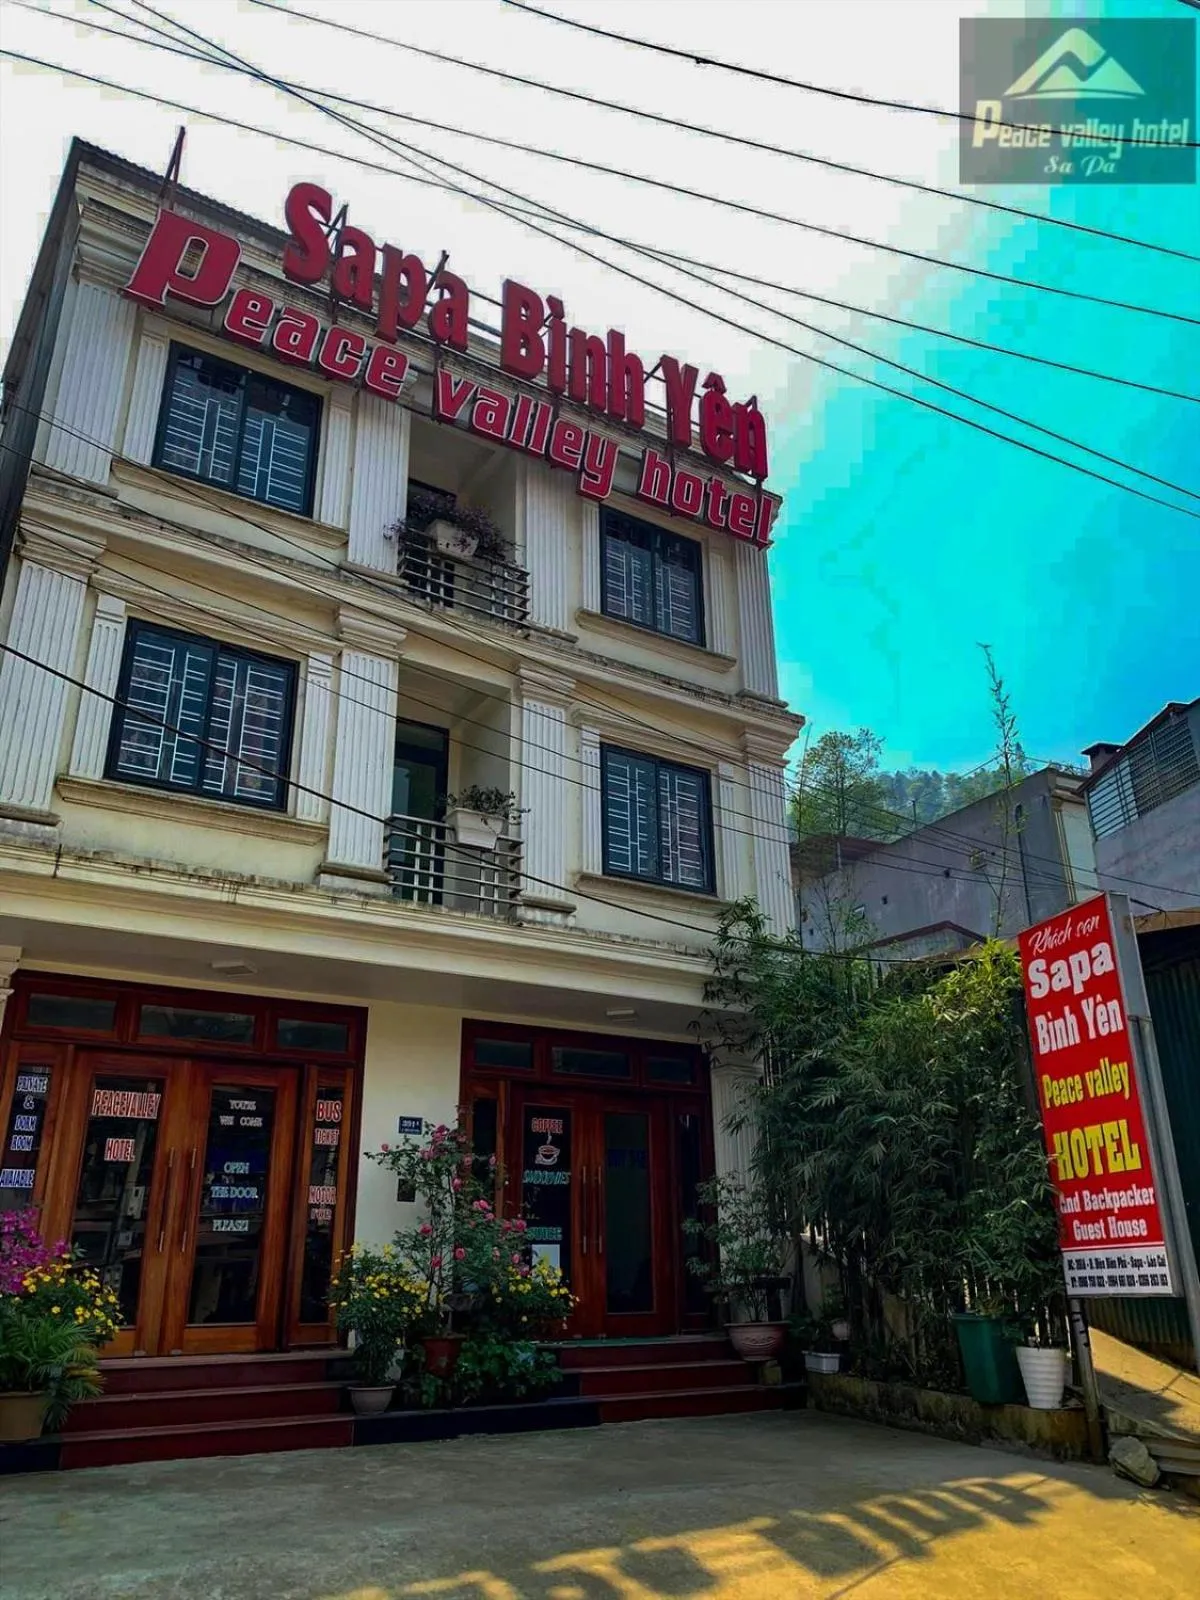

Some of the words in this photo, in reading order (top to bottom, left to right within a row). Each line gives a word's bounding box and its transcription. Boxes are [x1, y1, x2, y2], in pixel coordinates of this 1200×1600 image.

[282, 182, 469, 353] Sapa
[501, 279, 645, 431] Bình
[661, 355, 768, 480] Yên
[122, 206, 410, 401] Peace
[432, 368, 620, 499] valley
[637, 447, 777, 551] hotel
[1028, 917, 1073, 957] Khách
[1074, 915, 1100, 938] sạn
[1028, 942, 1115, 999] Sapa
[1035, 1006, 1081, 1055] Bình
[1081, 994, 1124, 1040] Yên
[1042, 1073, 1084, 1109] Peace
[1084, 1057, 1130, 1100] valley
[316, 1100, 341, 1122] BUS
[104, 1138, 136, 1161] HOTEL
[224, 1162, 249, 1174] OPEN
[1053, 1119, 1142, 1181] HOTEL
[1082, 1183, 1155, 1213] Backpacker
[1072, 1219, 1107, 1241] Guest
[1107, 1216, 1148, 1239] House
